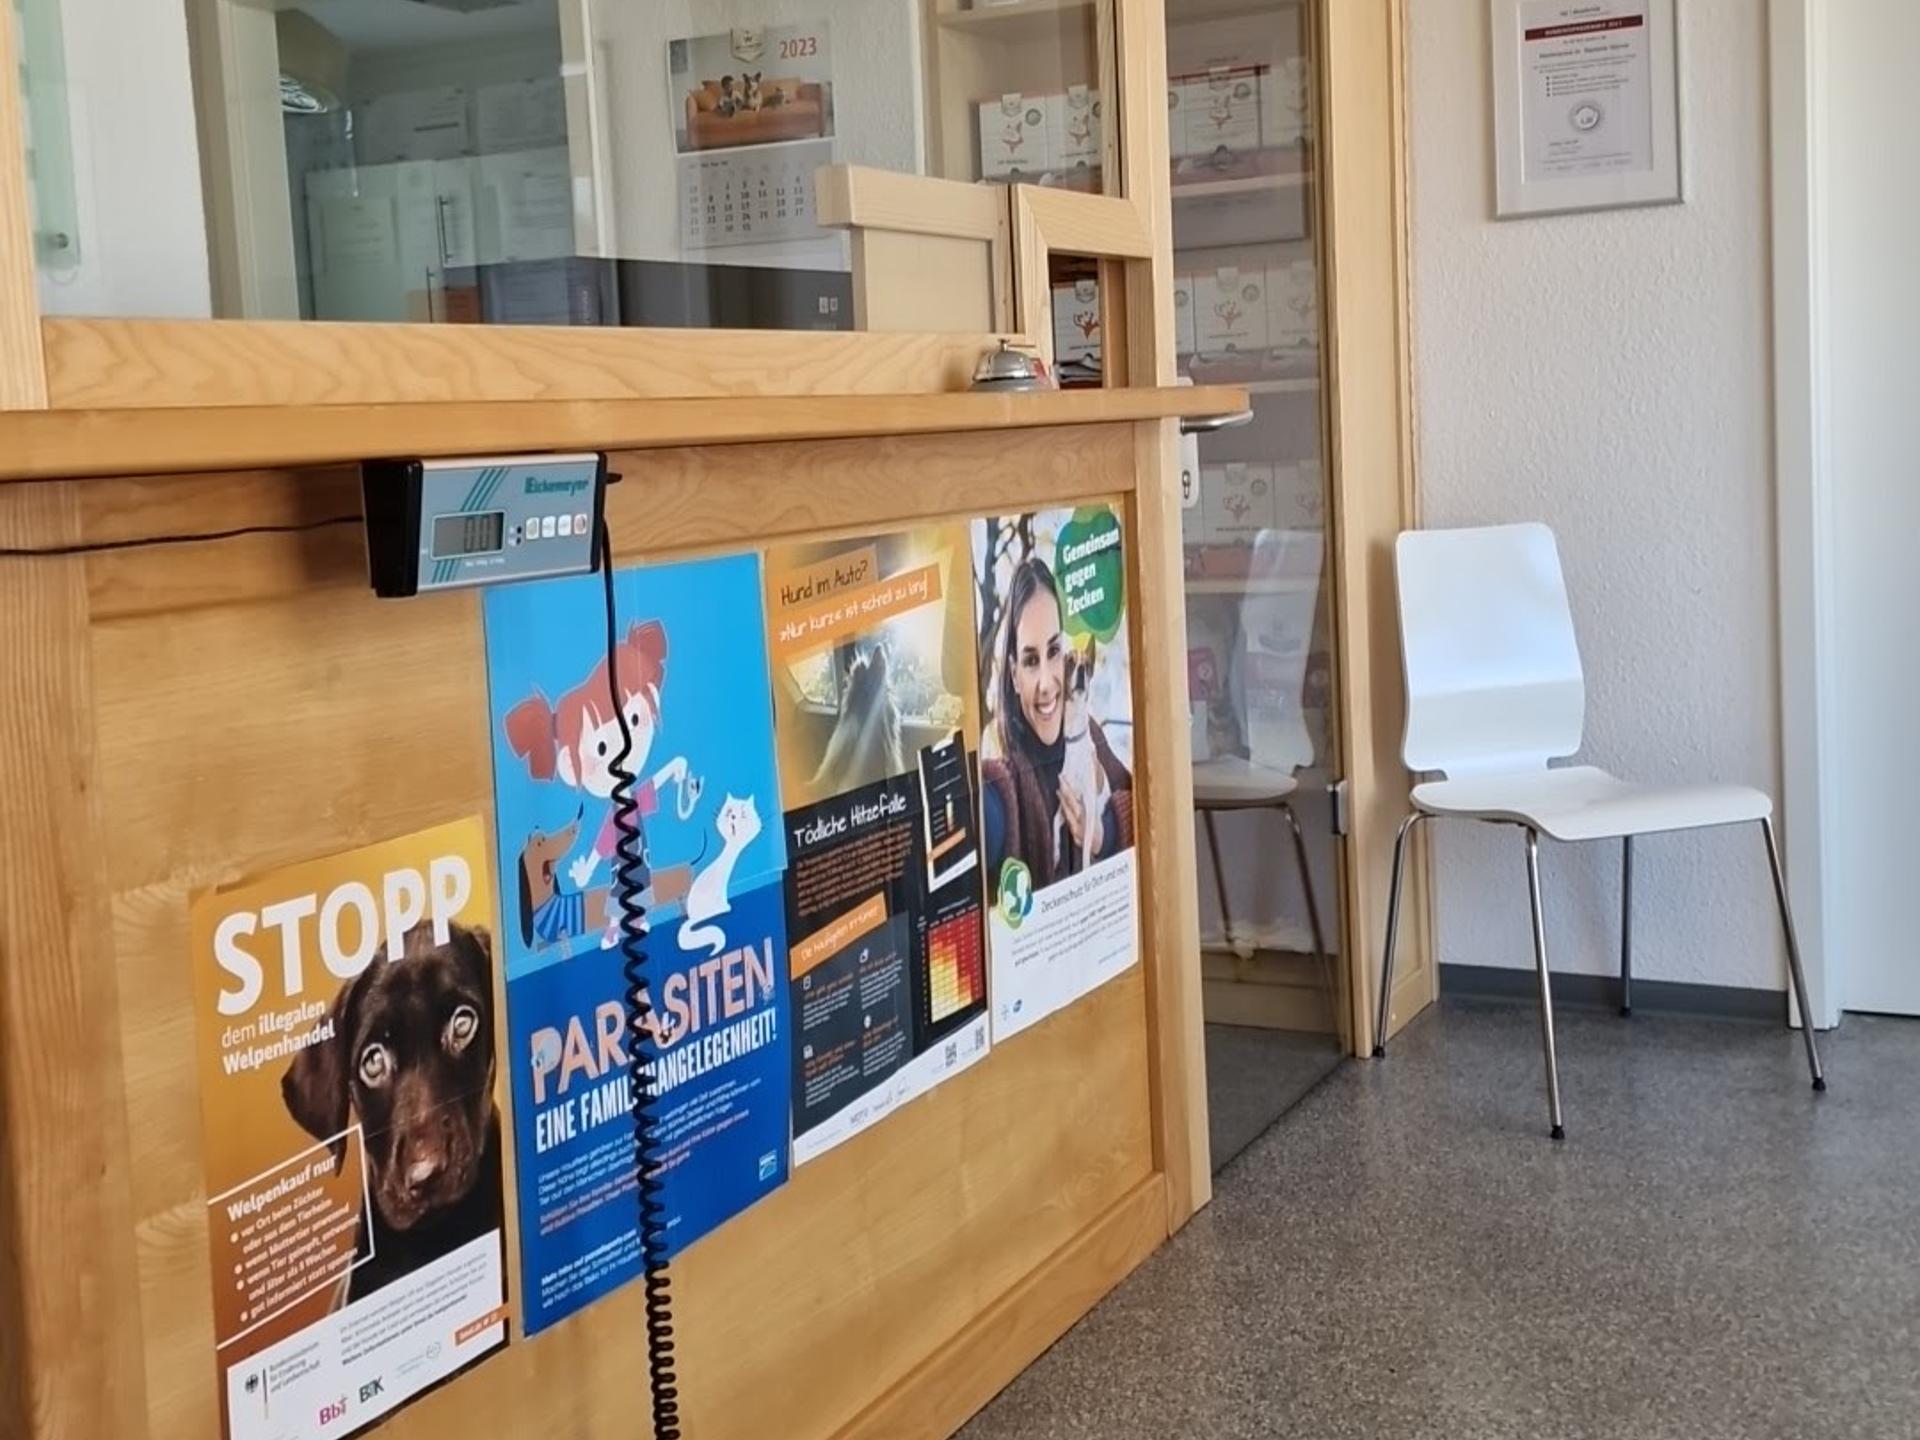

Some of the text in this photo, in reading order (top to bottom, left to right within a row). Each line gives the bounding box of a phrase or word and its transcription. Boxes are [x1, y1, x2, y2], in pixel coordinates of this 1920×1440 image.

[780, 37, 817, 59] 2023
[525, 476, 589, 497] Eickemeyer
[1063, 528, 1120, 564] Gemeinsam
[781, 559, 868, 607] Hund im Auto?
[1064, 563, 1096, 593] gegen
[845, 600, 859, 618] ist
[894, 587, 907, 601] zu
[1066, 587, 1105, 616] Zecken
[794, 815, 847, 848] Tödliche
[213, 855, 472, 1016] STOPP
[221, 1000, 326, 1048] dem illegalen
[222, 1018, 336, 1076] Welpenhandel
[535, 1099, 578, 1154] EINE
[580, 1006, 778, 1133] FAMILNANGELEGENHEIT!
[227, 1155, 337, 1222] Welpenkauf nur
